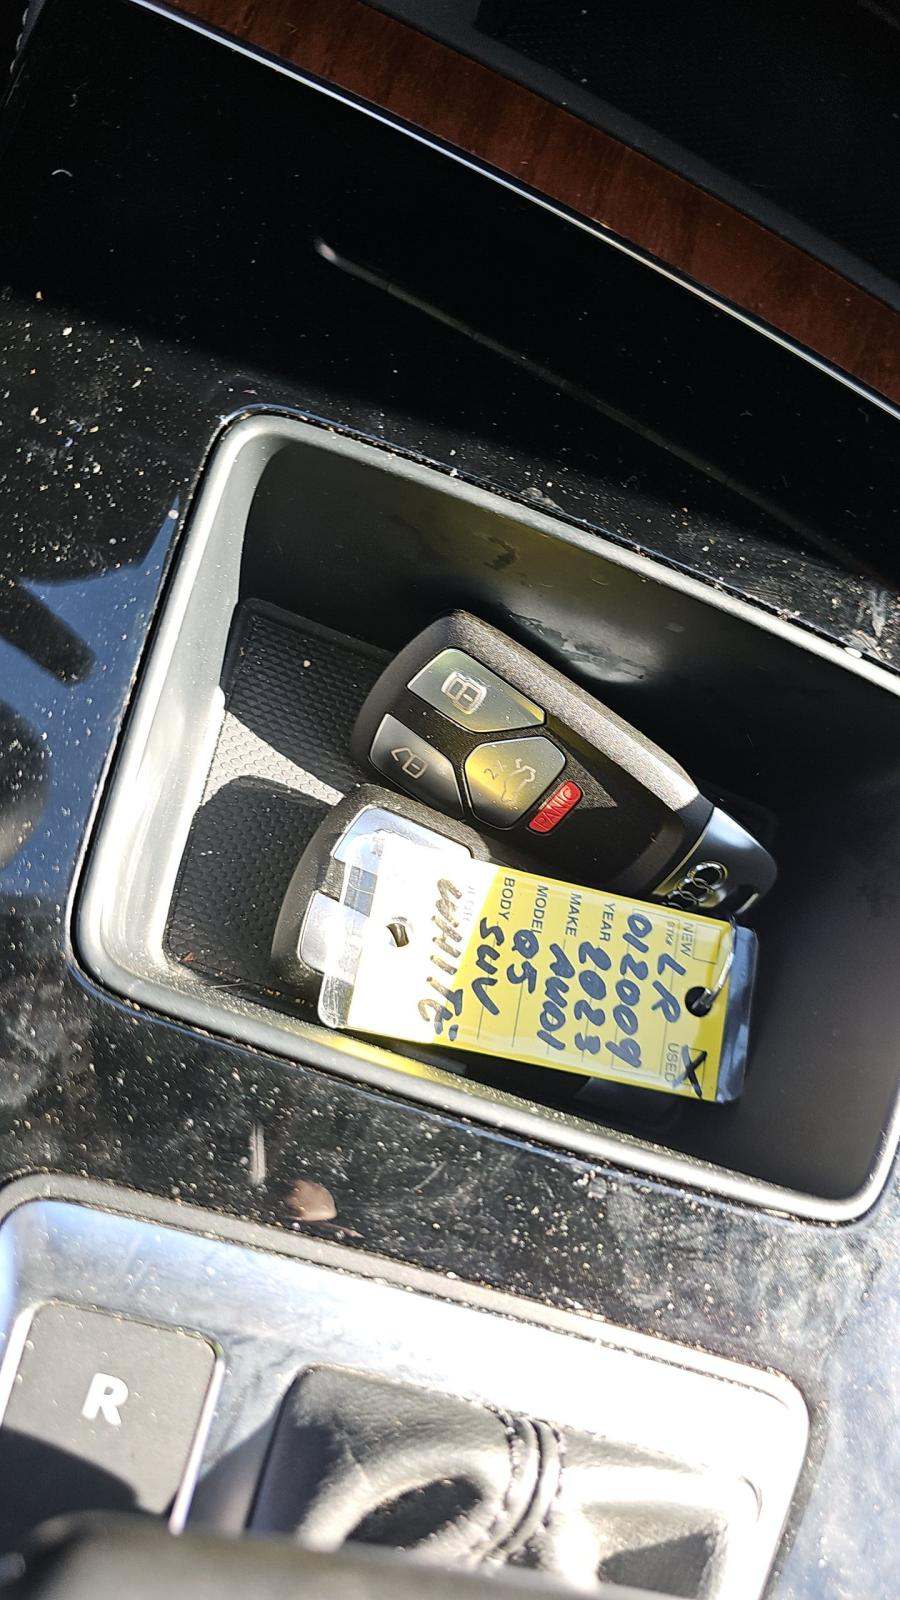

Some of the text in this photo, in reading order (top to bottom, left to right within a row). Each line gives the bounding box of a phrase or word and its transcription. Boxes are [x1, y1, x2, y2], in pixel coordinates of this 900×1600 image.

[534, 785, 573, 830] PANIC
[498, 877, 515, 921] BODY
[565, 891, 582, 937] MAKE
[600, 903, 615, 943] YEAR
[506, 929, 540, 994] Q5
[681, 922, 694, 957] NEW
[471, 917, 505, 1015] SUV
[605, 913, 653, 1068] 012009
[537, 943, 576, 1050] AUDI
[574, 941, 612, 1055] 2023
[665, 1043, 679, 1082] USED
[82, 1372, 129, 1426] R
